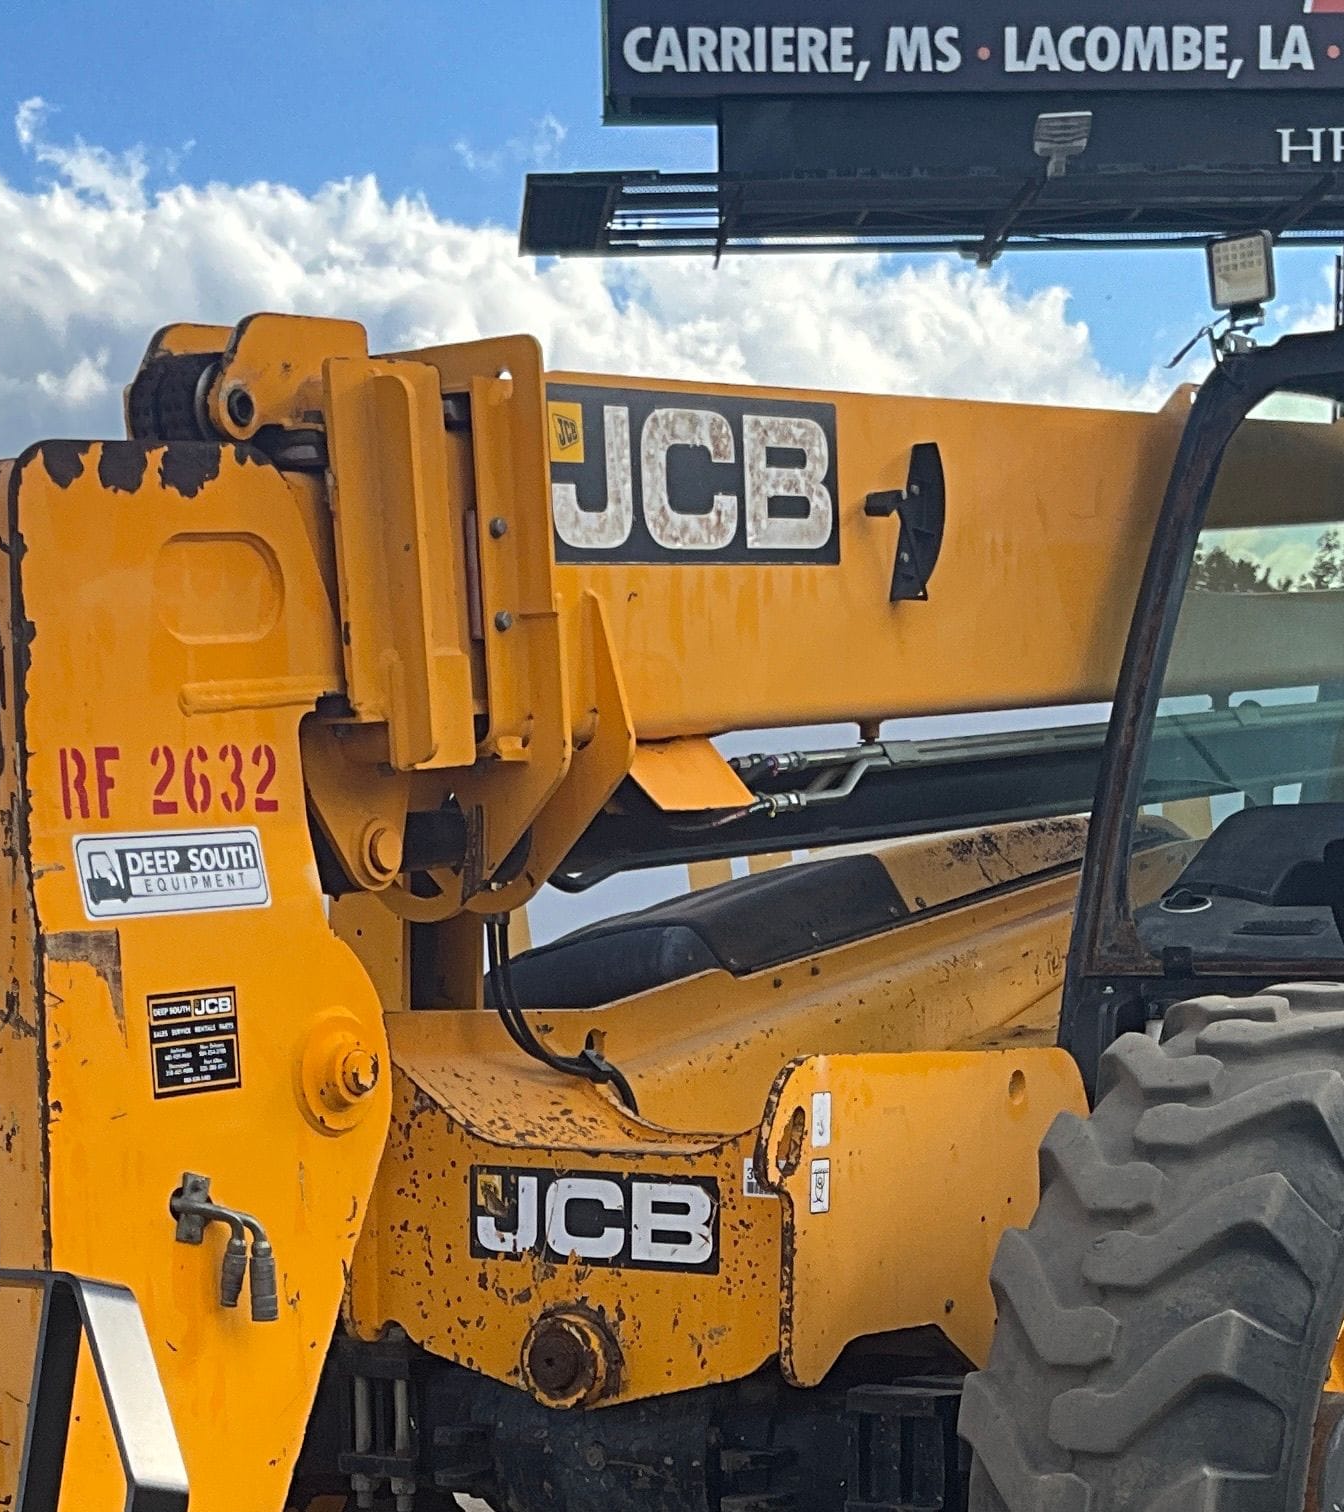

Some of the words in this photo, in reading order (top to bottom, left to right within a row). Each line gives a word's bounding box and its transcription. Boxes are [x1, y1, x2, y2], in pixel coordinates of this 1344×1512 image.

[622, 25, 870, 81] CARRIERE,
[884, 25, 962, 74] MS
[1004, 24, 1244, 80] LACOMBE,
[1258, 25, 1314, 71] LA
[551, 404, 834, 550] JCB
[60, 746, 120, 820] RF
[150, 743, 278, 816] 2632
[126, 850, 180, 875] DEEP
[187, 845, 258, 872] SOUTH
[145, 872, 247, 893] EQUIPMENT
[195, 997, 231, 1015] JCB
[476, 1175, 714, 1265] JCB
